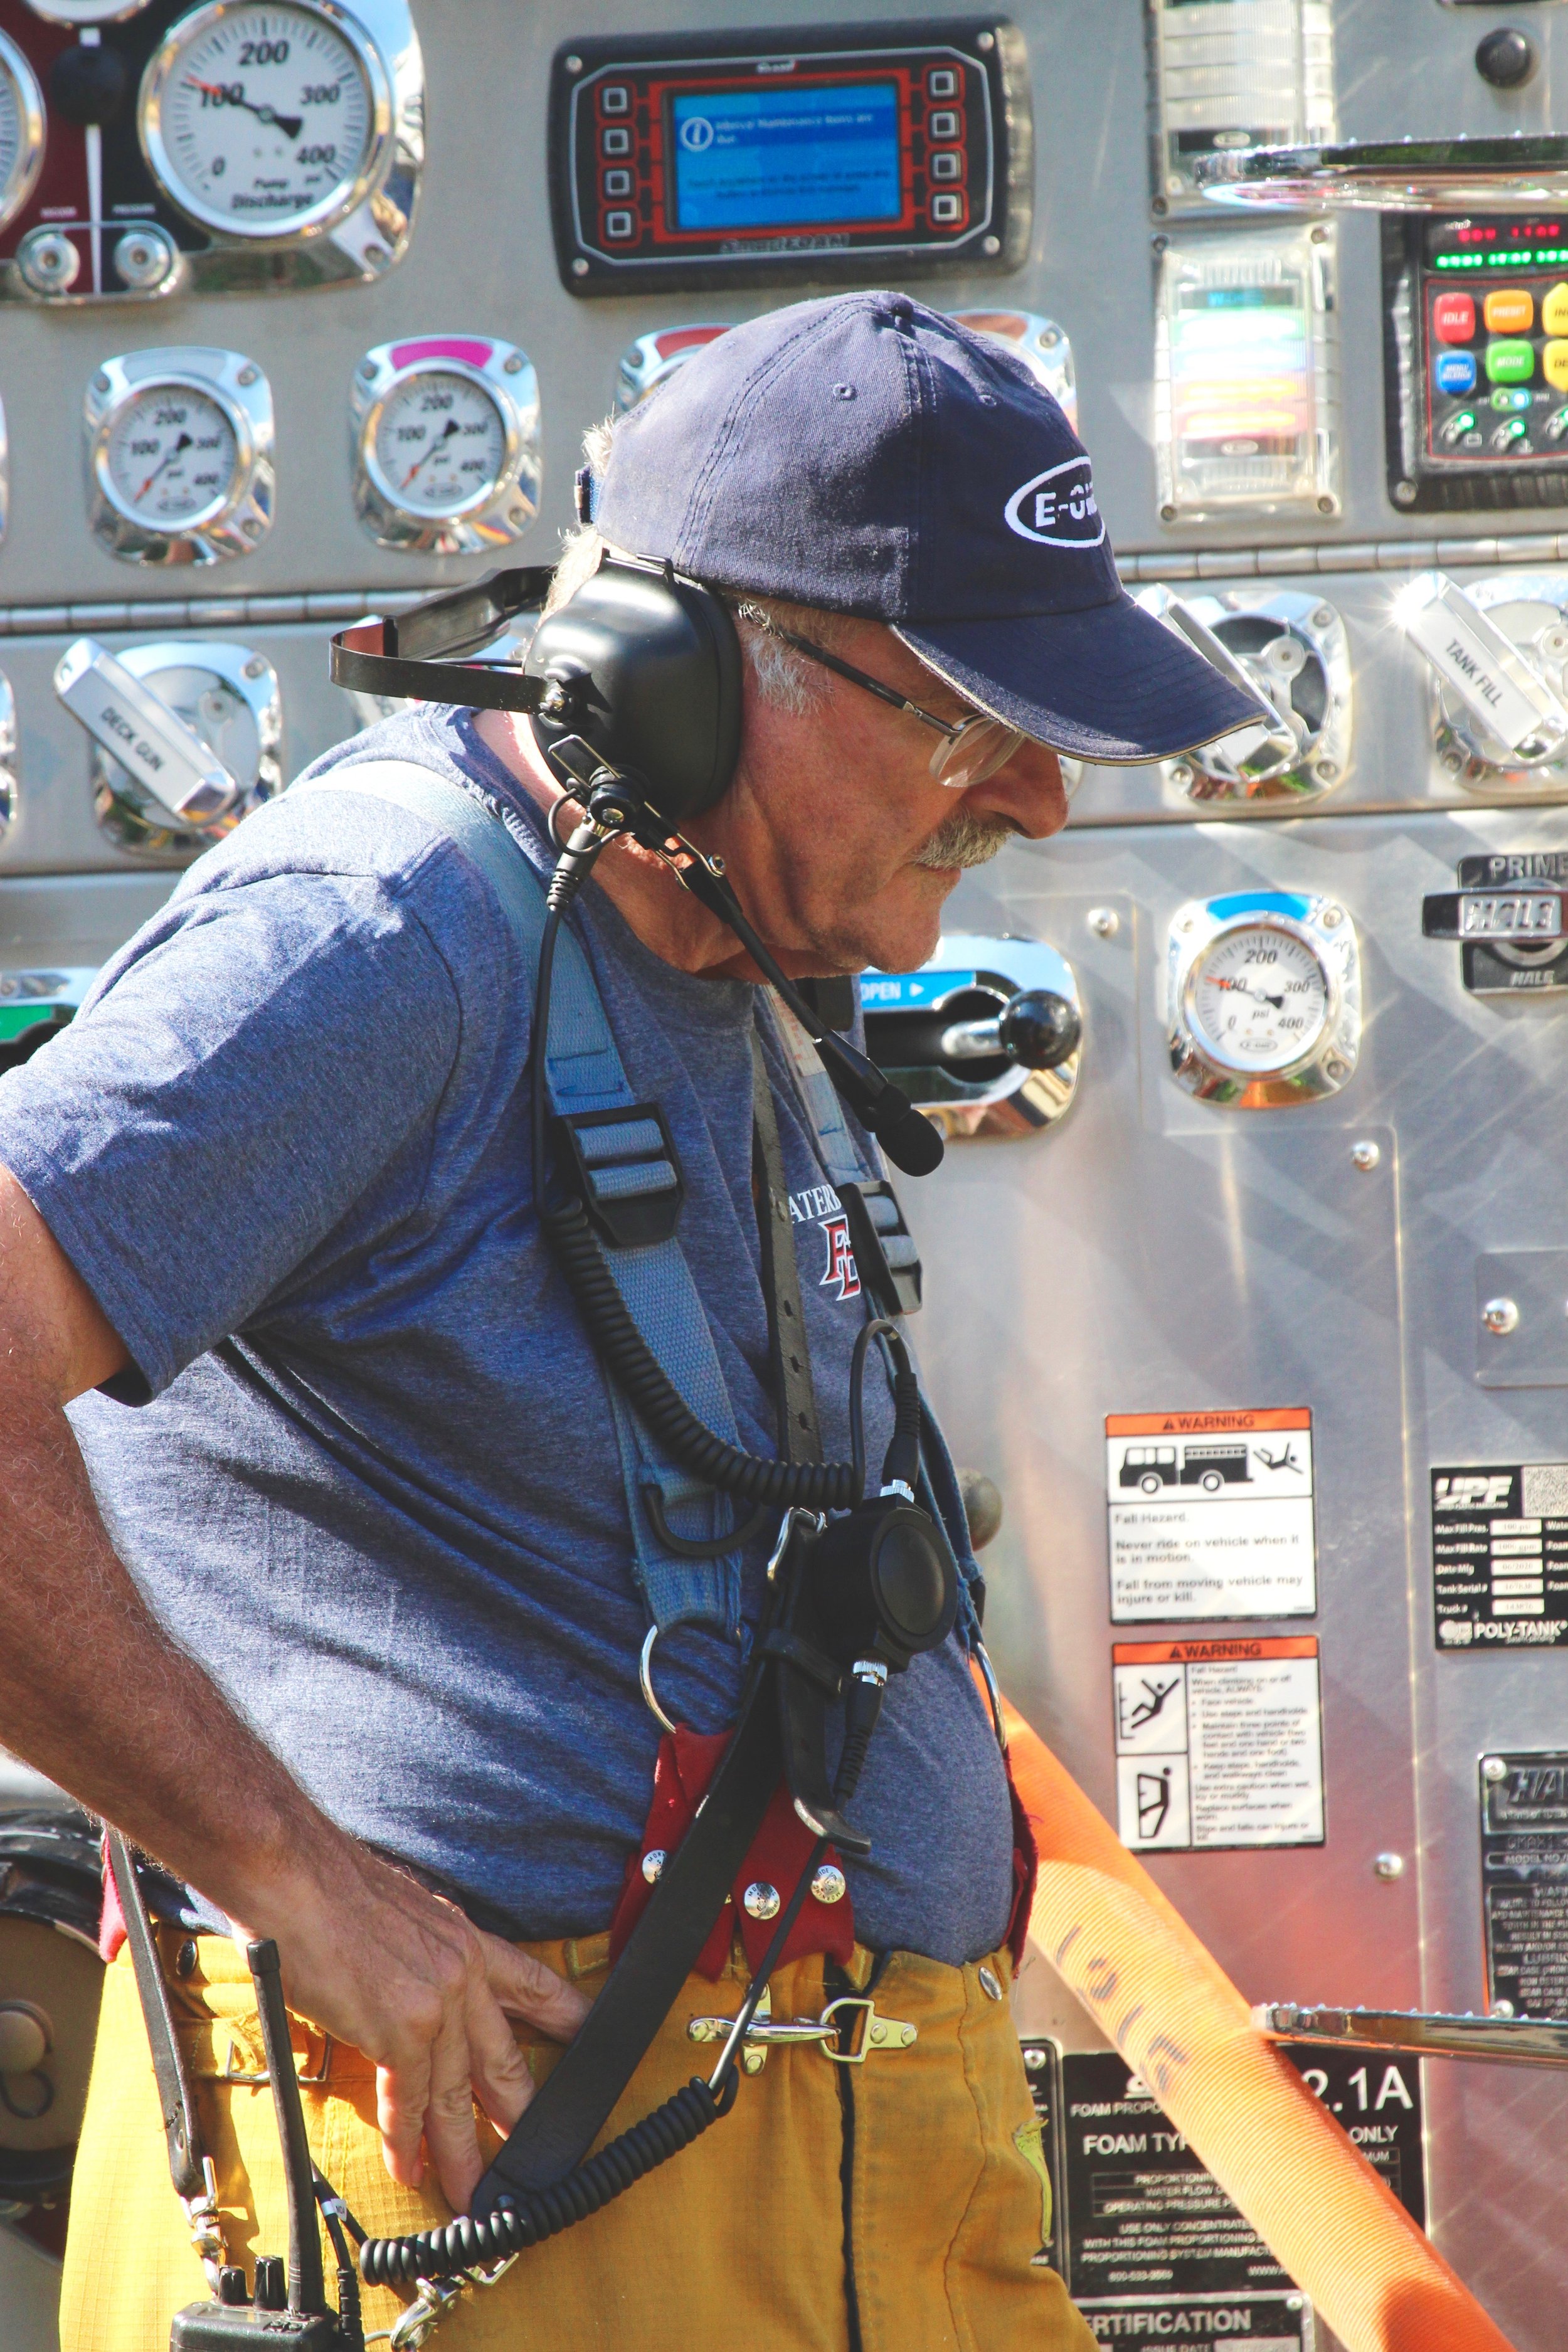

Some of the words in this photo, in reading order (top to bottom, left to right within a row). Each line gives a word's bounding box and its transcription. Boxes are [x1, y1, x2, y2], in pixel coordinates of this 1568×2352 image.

[240, 39, 290, 66] 200
[300, 83, 341, 105] 300
[212, 156, 226, 177] 0
[297, 144, 336, 164] 400
[1443, 311, 1469, 326] IDLE
[1497, 356, 1525, 368] MODE
[421, 393, 454, 412] 200
[155, 409, 188, 426] 200
[398, 424, 426, 442] 100
[131, 440, 159, 455] 100
[460, 458, 487, 472] 400
[194, 474, 220, 485] 400
[1446, 638, 1481, 679] TANK
[1475, 674, 1504, 708] FILL
[100, 706, 136, 746] DECK
[135, 741, 166, 772] GUN
[1244, 948, 1278, 964] 200
[1511, 970, 1555, 987] HALE
[1285, 980, 1310, 993] 300
[1227, 1015, 1236, 1029] 0
[1252, 1009, 1270, 1020] psi
[1278, 1017, 1305, 1029] 400
[1177, 1412, 1255, 1429] WARNING
[1434, 1476, 1513, 1505] UPF
[1115, 1513, 1138, 1524] Fall
[1435, 1525, 1454, 1535] Max
[1455, 1523, 1468, 1534] Fill
[1116, 1540, 1152, 1550] Never
[1157, 1539, 1180, 1549] ride
[1185, 1540, 1201, 1549] on
[1205, 1537, 1249, 1548] vehicle
[1253, 1535, 1288, 1545] when
[1435, 1544, 1456, 1555] Max
[1456, 1543, 1469, 1554] Fill
[1469, 1542, 1488, 1554] Rate
[1116, 1554, 1126, 1564] is
[1131, 1553, 1143, 1564] in
[1435, 1564, 1458, 1576] Date
[1457, 1563, 1475, 1576] Mfg
[1117, 1579, 1140, 1591] Fall
[1144, 1579, 1173, 1589] from
[1177, 1577, 1224, 1589] moving
[1228, 1575, 1273, 1587] vehicle
[1277, 1576, 1303, 1587] may
[1436, 1584, 1457, 1595] Tank
[1456, 1582, 1481, 1594] Serial
[1118, 1593, 1153, 1606] injure
[1157, 1594, 1170, 1603] or
[1436, 1604, 1461, 1615] Truck
[1461, 1604, 1468, 1614] #
[1185, 1643, 1262, 1657] WARNING
[1070, 2103, 1111, 2117] FOAM
[1349, 2125, 1399, 2144] ONLY
[1083, 2134, 1147, 2156] FOAM
[1182, 2185, 1214, 2196] FLOW
[1103, 2200, 1164, 2214] OPERATING
[1164, 2198, 1223, 2210] PRESSURE
[1119, 2223, 1142, 2235] USE
[1142, 2221, 1170, 2233] ONLY
[1083, 2237, 1111, 2250] WITH
[1112, 2237, 1136, 2249] THIS
[1137, 2235, 1168, 2247] FOAM
[1168, 2232, 1256, 2246] PROPORTIONING
[1079, 2248, 1168, 2264] PROPORTIONING
[1168, 2247, 1212, 2260] SYSTEM
